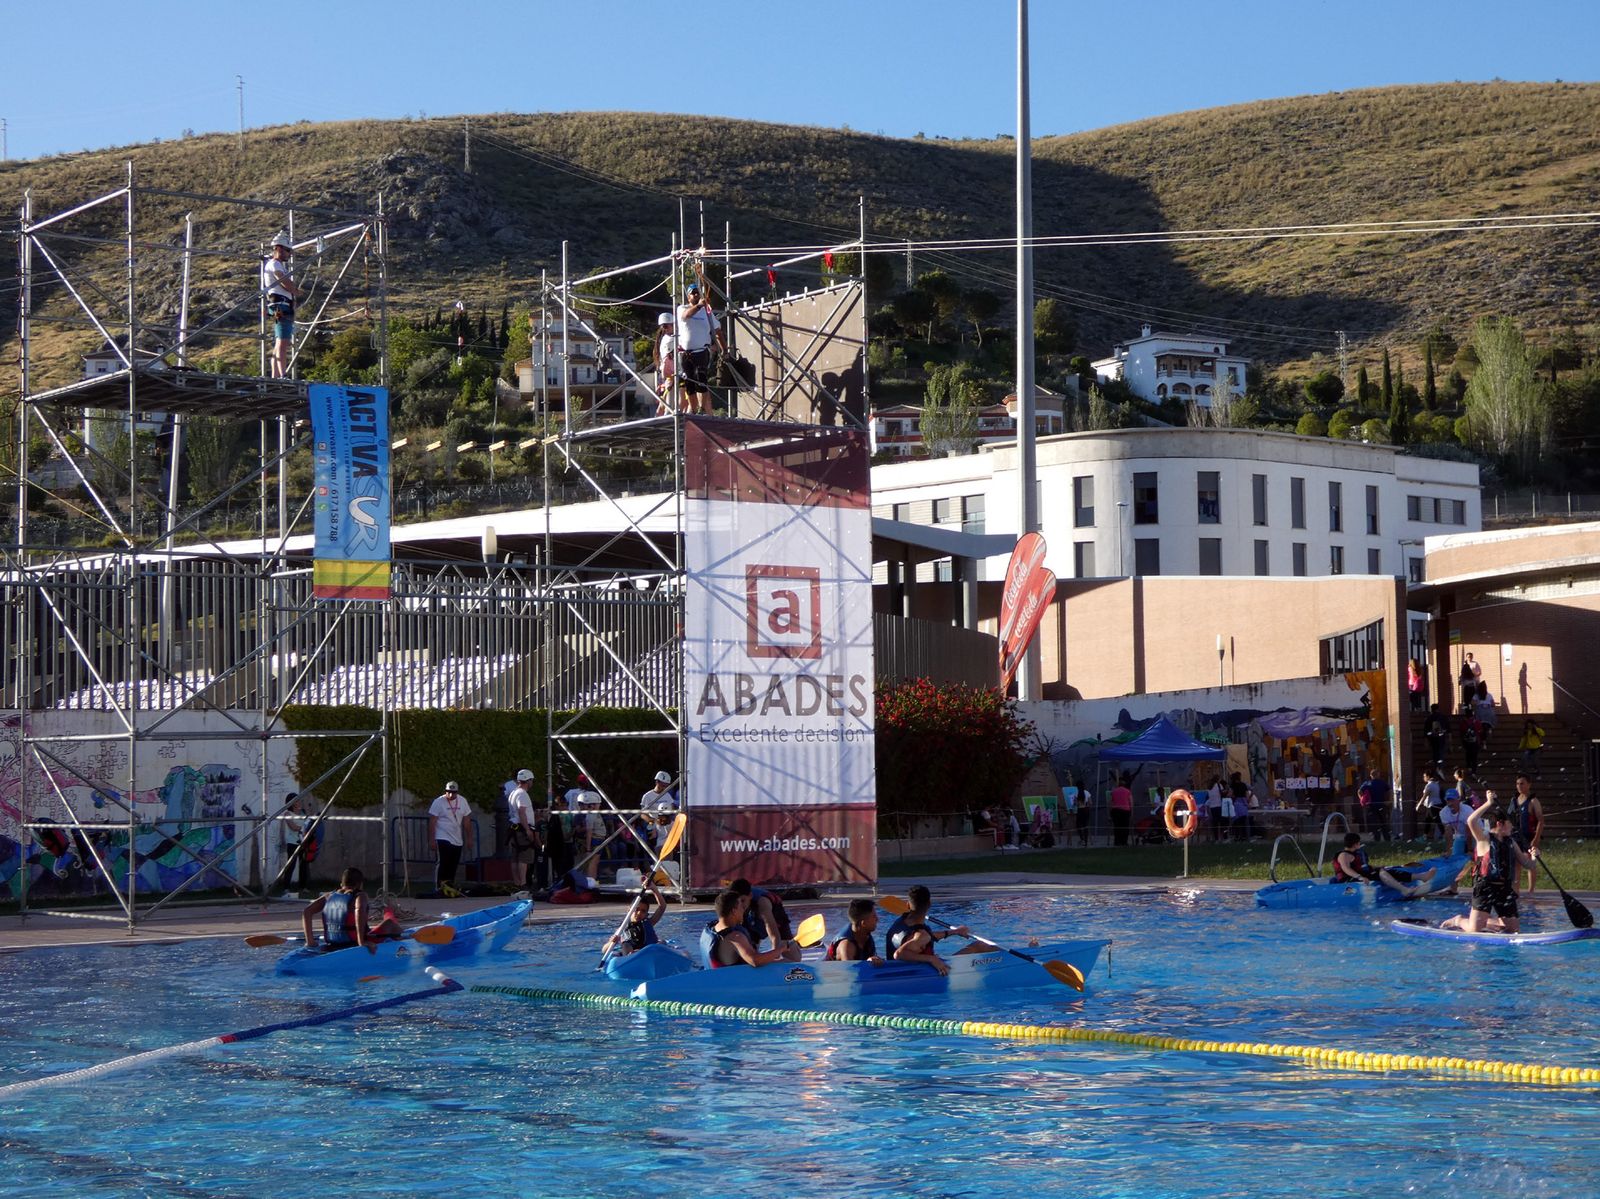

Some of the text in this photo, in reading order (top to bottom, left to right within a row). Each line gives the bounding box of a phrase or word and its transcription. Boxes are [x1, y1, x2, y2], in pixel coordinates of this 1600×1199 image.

[325, 396, 337, 480] www.activasur.com
[331, 489, 339, 505] 617
[330, 508, 339, 524] 158
[329, 526, 338, 542] 788
[696, 673, 868, 717] ABADES
[699, 722, 865, 743] Excelente decisión
[720, 834, 850, 853] www.abades.com
